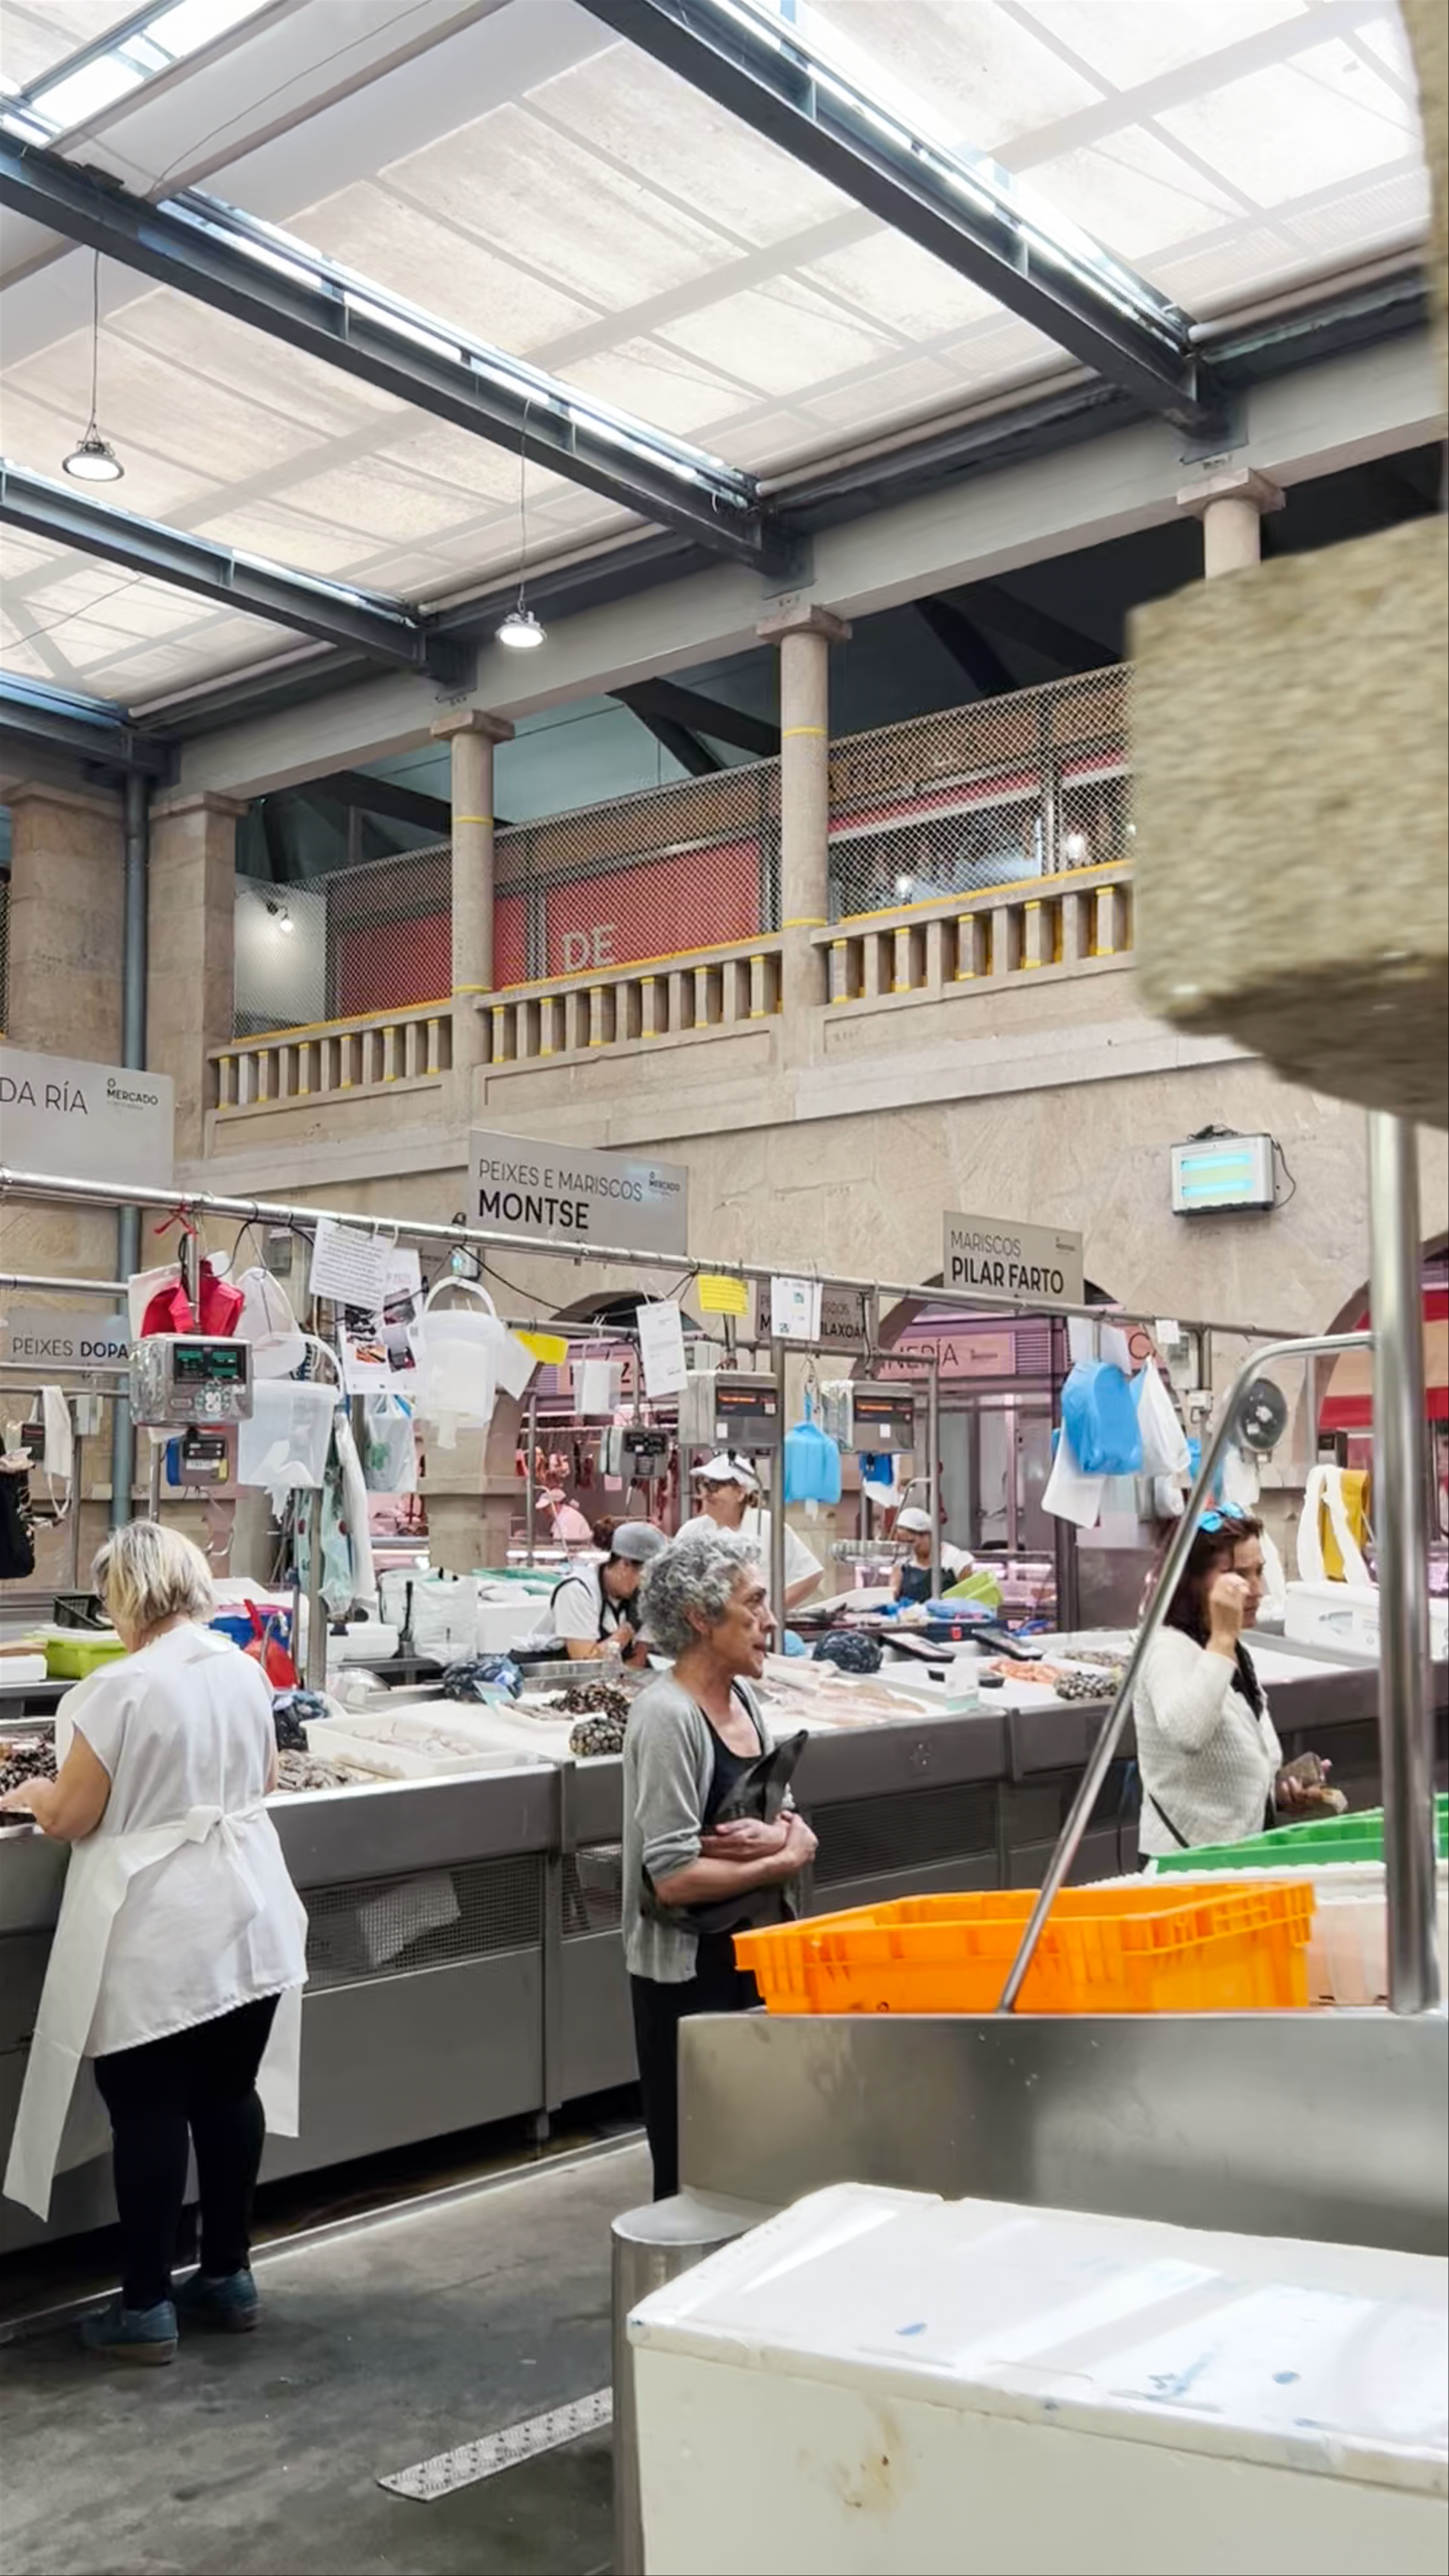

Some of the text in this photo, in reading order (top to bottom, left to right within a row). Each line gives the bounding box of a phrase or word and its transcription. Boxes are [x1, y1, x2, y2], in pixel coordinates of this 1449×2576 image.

[562, 923, 615, 972] DE
[0, 1077, 88, 1115] DA RÍA
[107, 1089, 158, 1105] MERCADO
[479, 1159, 642, 1202] PEIXES E MARISCOS
[479, 1189, 589, 1229] MONTSE
[951, 1230, 1020, 1258] MARISCOS
[952, 1256, 1064, 1293] PILAR FARTO
[12, 1337, 74, 1357] PEIXES
